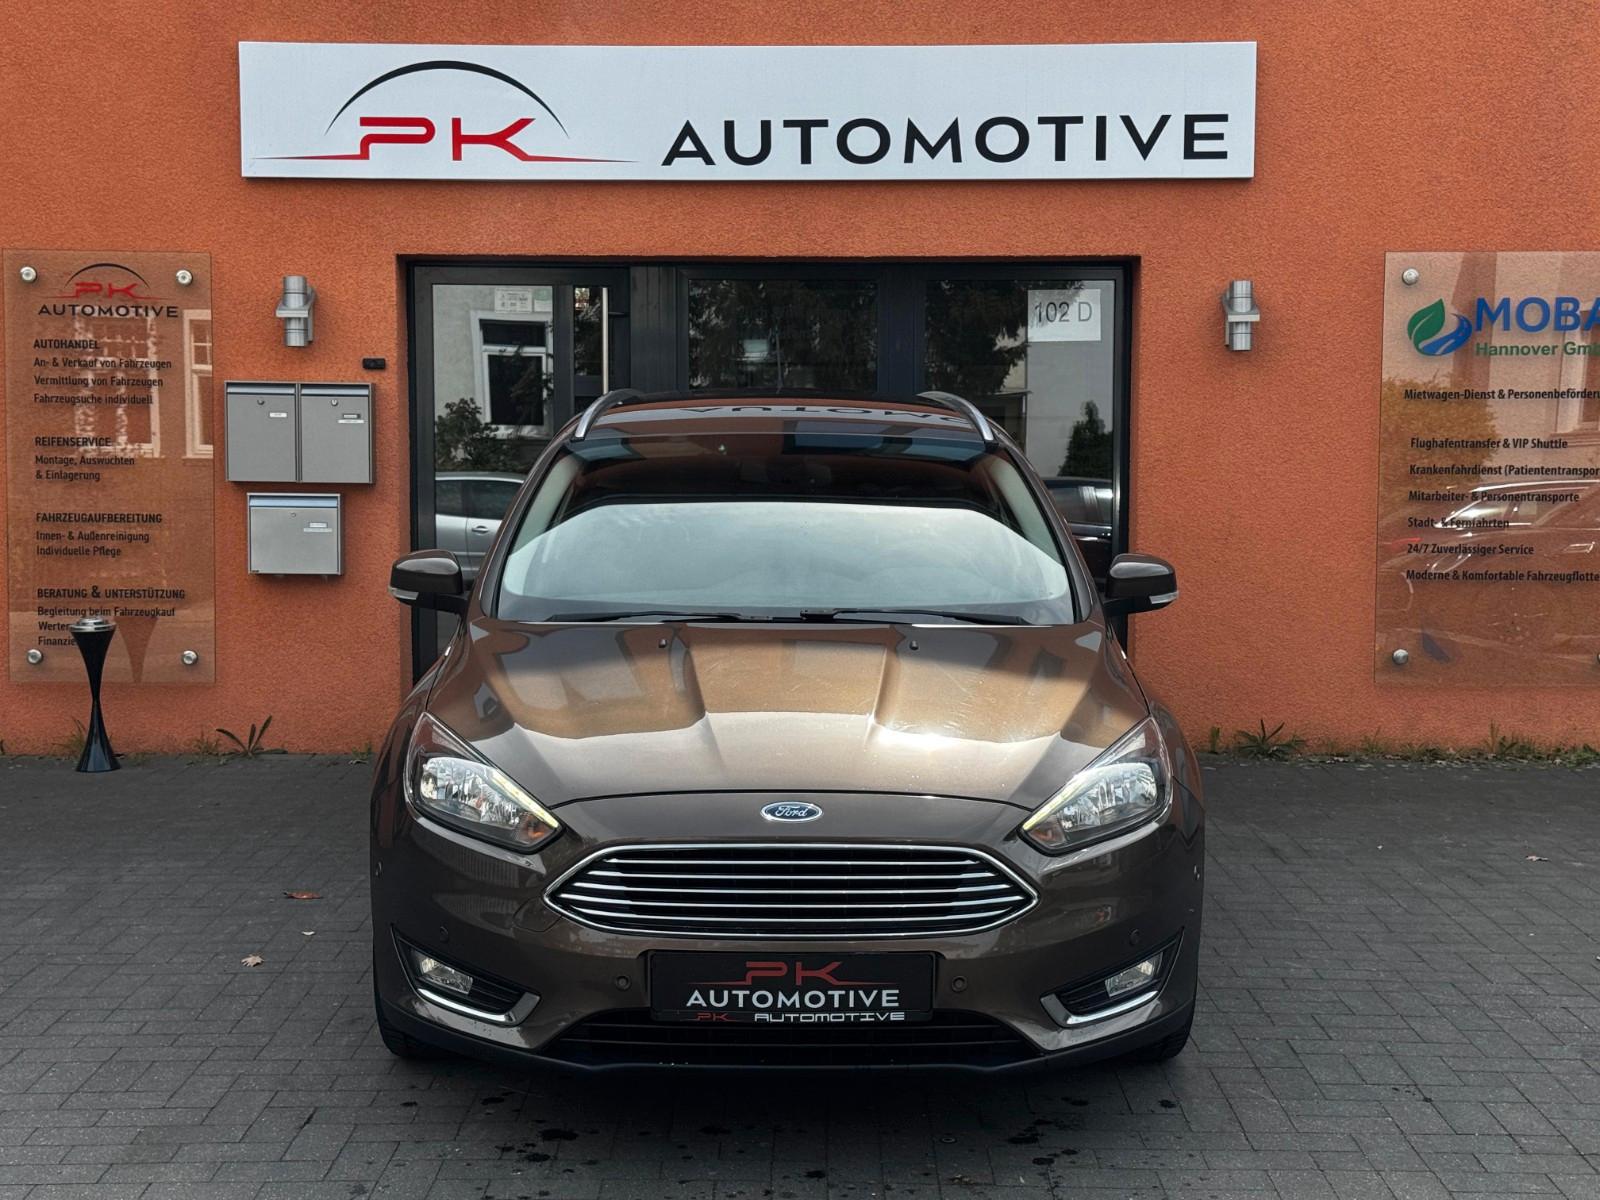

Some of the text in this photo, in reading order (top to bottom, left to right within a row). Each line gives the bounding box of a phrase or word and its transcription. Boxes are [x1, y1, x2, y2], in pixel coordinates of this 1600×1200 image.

[359, 113, 1229, 167] PK AUTOMOTIVE
[38, 304, 179, 318] AUTOMOTIVE
[1034, 301, 1093, 323] 102 D
[33, 339, 100, 350] AUTOHANDEL
[1475, 342, 1558, 356] Hannover
[33, 358, 172, 370] An- & Verkauf von Fahrzeugen
[34, 376, 163, 388] Vermittlung von Fahrzeugen
[33, 394, 153, 405] Fahrzeugsuche individuell
[1404, 389, 1495, 401] Mietwagen-Dienst
[1498, 389, 1505, 399] &
[35, 437, 112, 447] REIFENSERVICE
[1411, 438, 1568, 450] Flughafentransfer & VIP Shuttle
[35, 455, 135, 466] Montage, Auswuchten
[36, 470, 100, 481] & Einlagerung
[1410, 465, 1502, 475] Krankenfahrdienst
[1409, 491, 1580, 504] Mitarbeiter- & Personentransporte
[36, 513, 163, 523] FAHRZEUGAUFBEREITUNG
[1408, 517, 1510, 528] Stadt- & Fernfahrten
[36, 531, 150, 543] Innen- & Außenreinigung
[36, 546, 122, 558] Individuelle Pflege
[1407, 543, 1534, 556] 24/7 Zuverlässiger Service
[1406, 570, 1600, 584] Moderne & Komfortable Fahrzeugflotte
[37, 585, 185, 599] BERATUNG & UNTERSTÜTZUNG
[37, 607, 175, 618] Begleitung beim Fahrzeugkauf
[775, 805, 809, 817] Ford
[686, 989, 900, 1009] AUTOMOTIVE
[754, 1012, 905, 1022] AUTOMOTIVE
